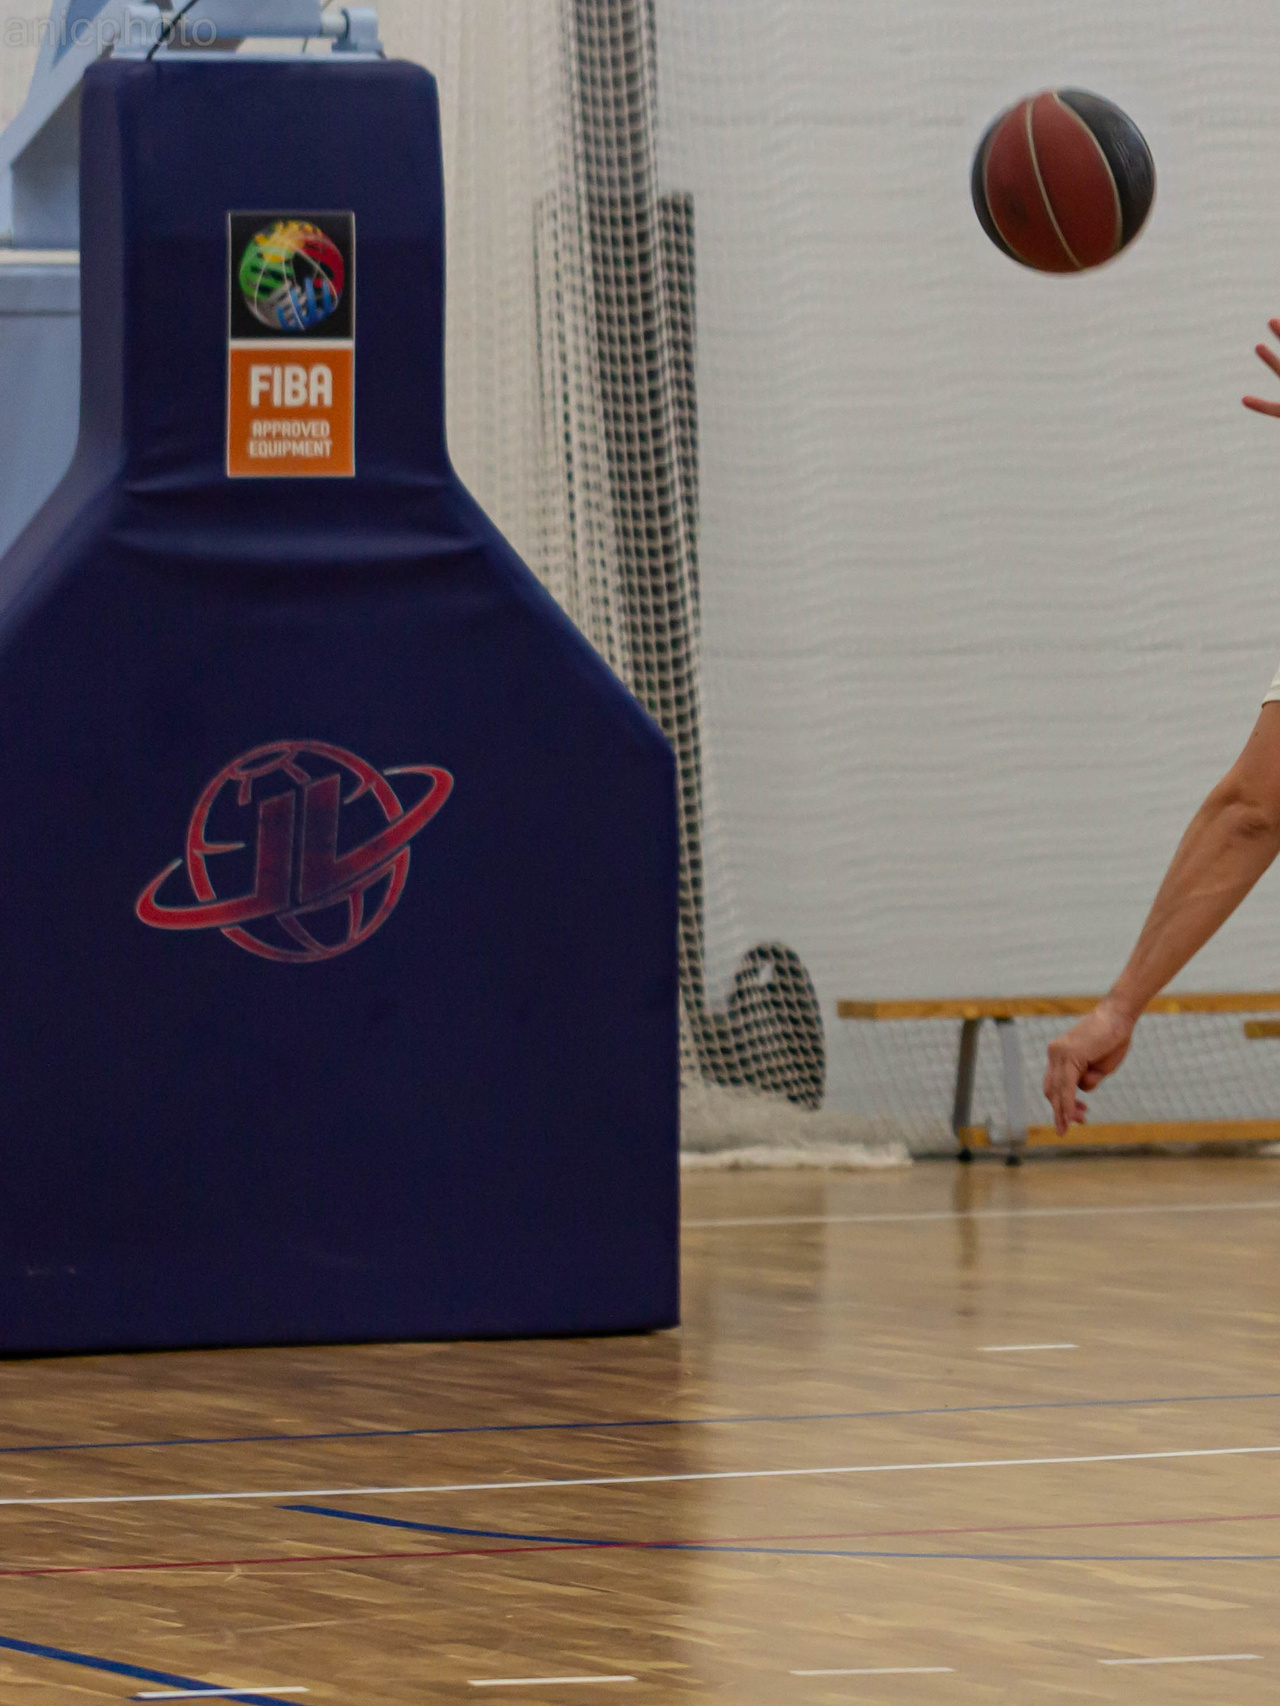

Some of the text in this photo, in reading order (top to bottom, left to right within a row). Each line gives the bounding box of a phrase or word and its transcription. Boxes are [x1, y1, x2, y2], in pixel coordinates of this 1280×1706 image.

[249, 364, 333, 407] FIBA
[251, 420, 330, 438] APPROVED
[248, 439, 332, 458] EQUIPMENT
